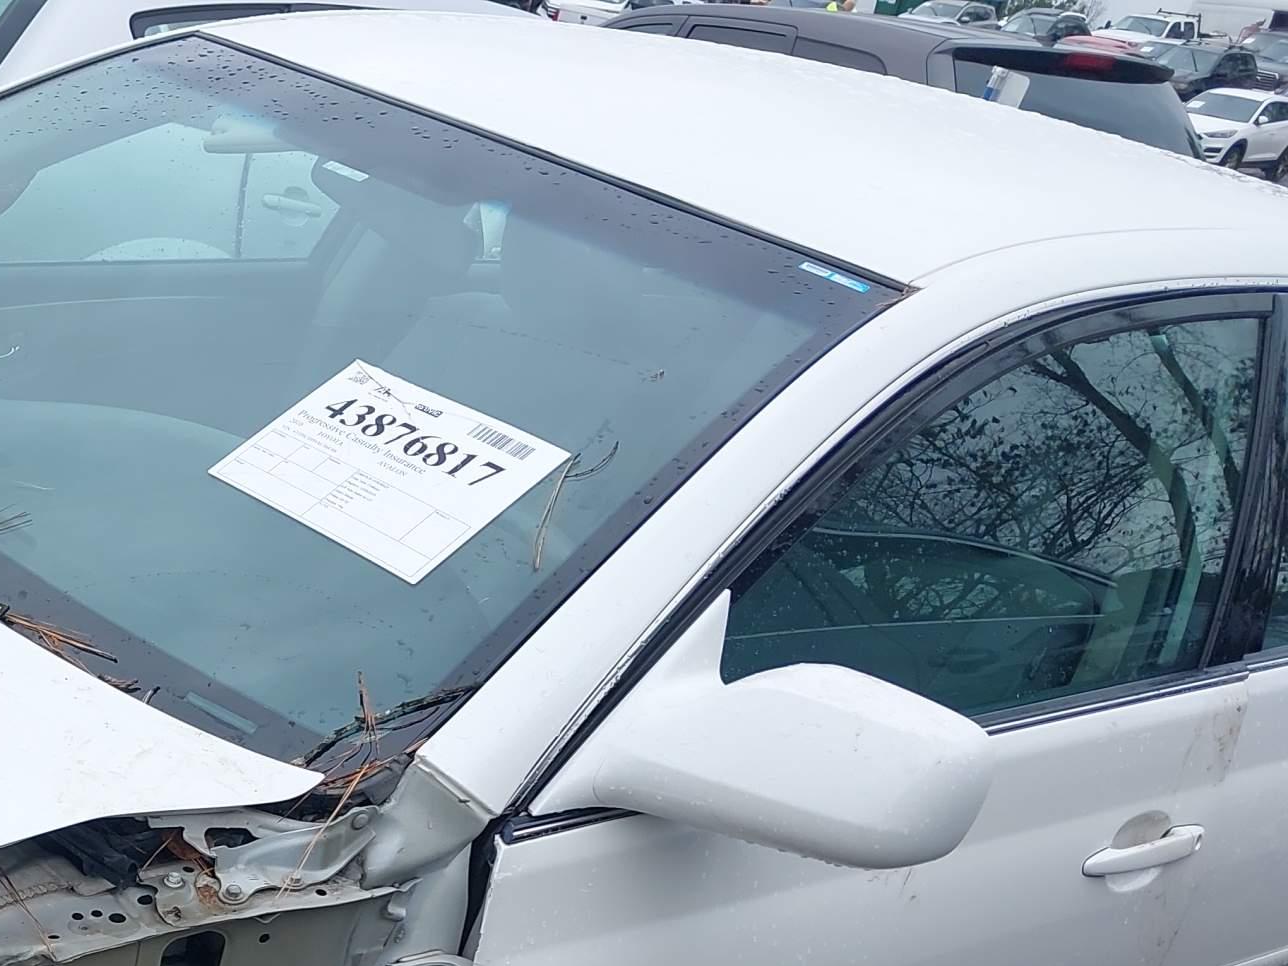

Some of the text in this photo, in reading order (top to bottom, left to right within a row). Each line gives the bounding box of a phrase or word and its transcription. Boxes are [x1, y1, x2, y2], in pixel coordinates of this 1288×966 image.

[298, 409, 346, 436] Progressive
[346, 431, 383, 454] Casualty
[383, 449, 426, 475] Insurance
[325, 399, 506, 486] 43876817
